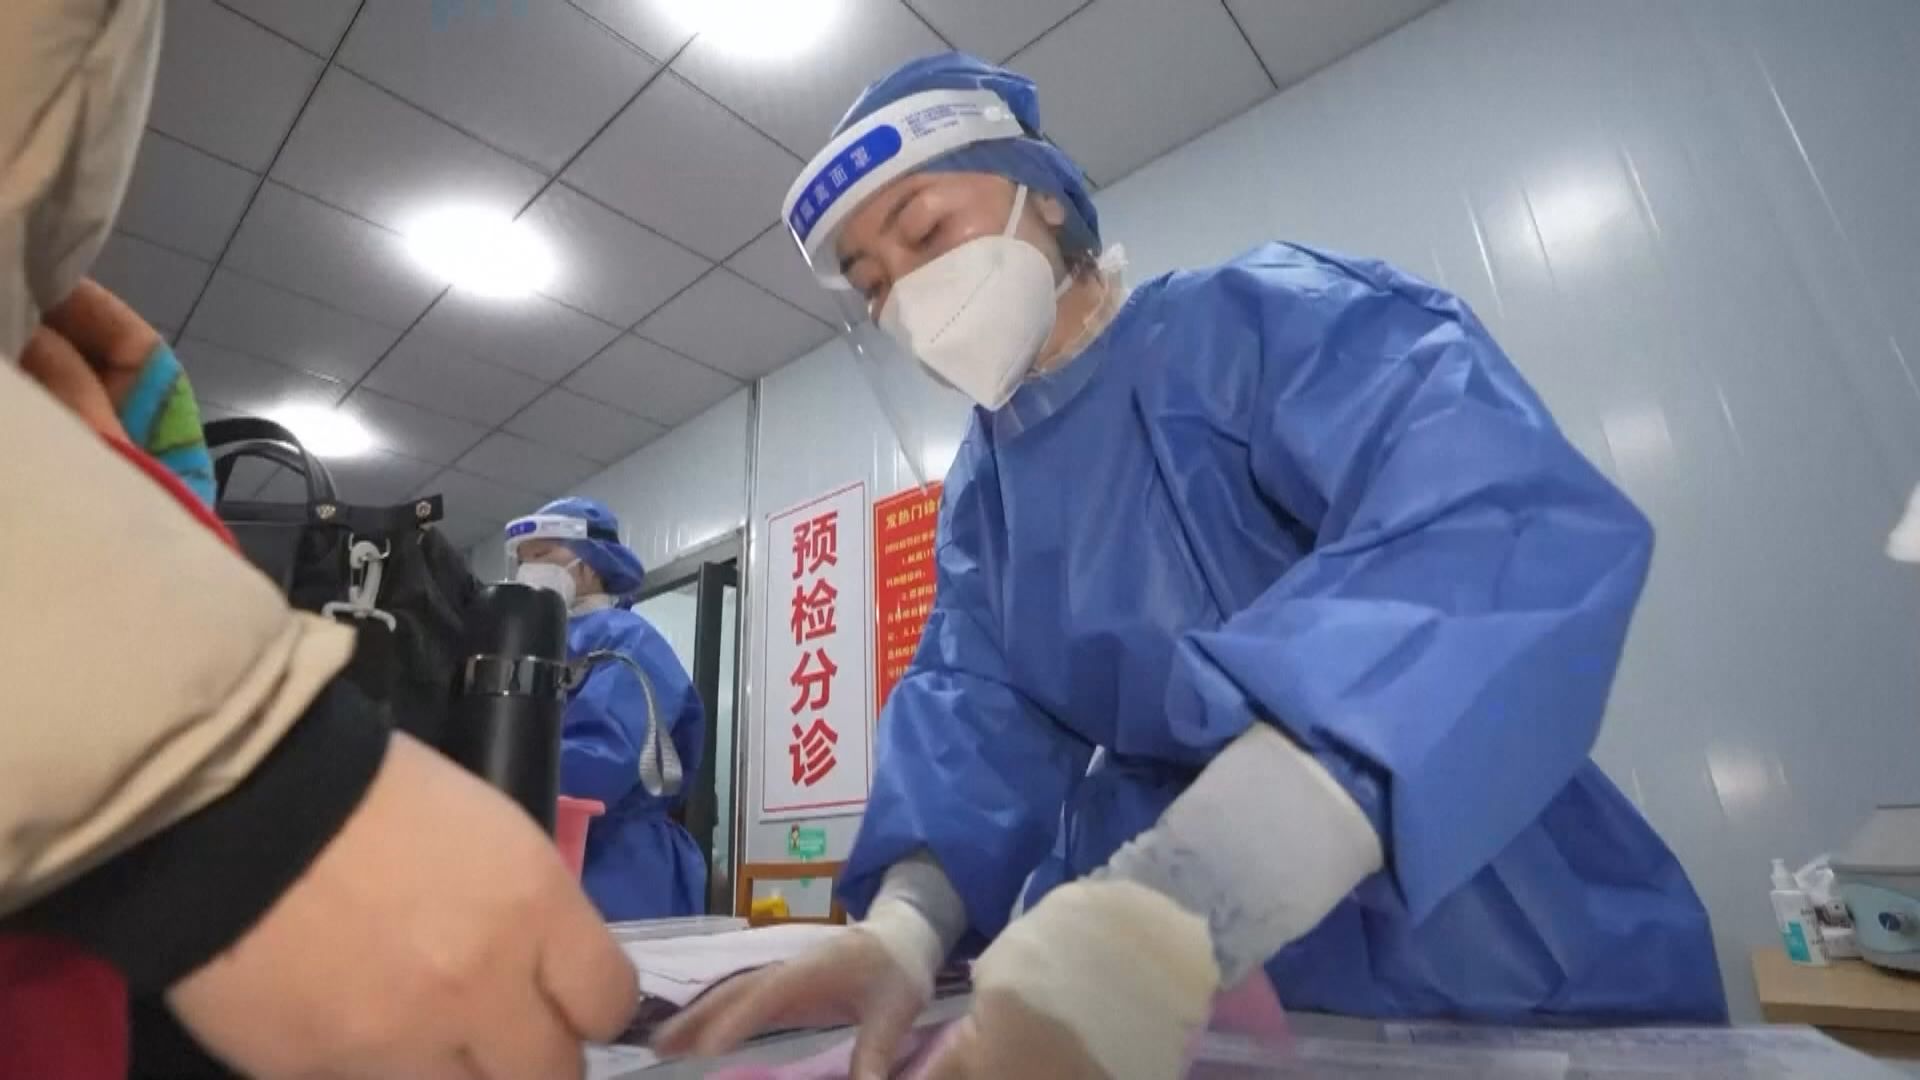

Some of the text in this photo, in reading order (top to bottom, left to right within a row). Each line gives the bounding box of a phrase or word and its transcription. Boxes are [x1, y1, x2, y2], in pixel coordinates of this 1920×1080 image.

[886, 498, 940, 530] 发热门诊
[789, 511, 838, 787] 预检分诊
